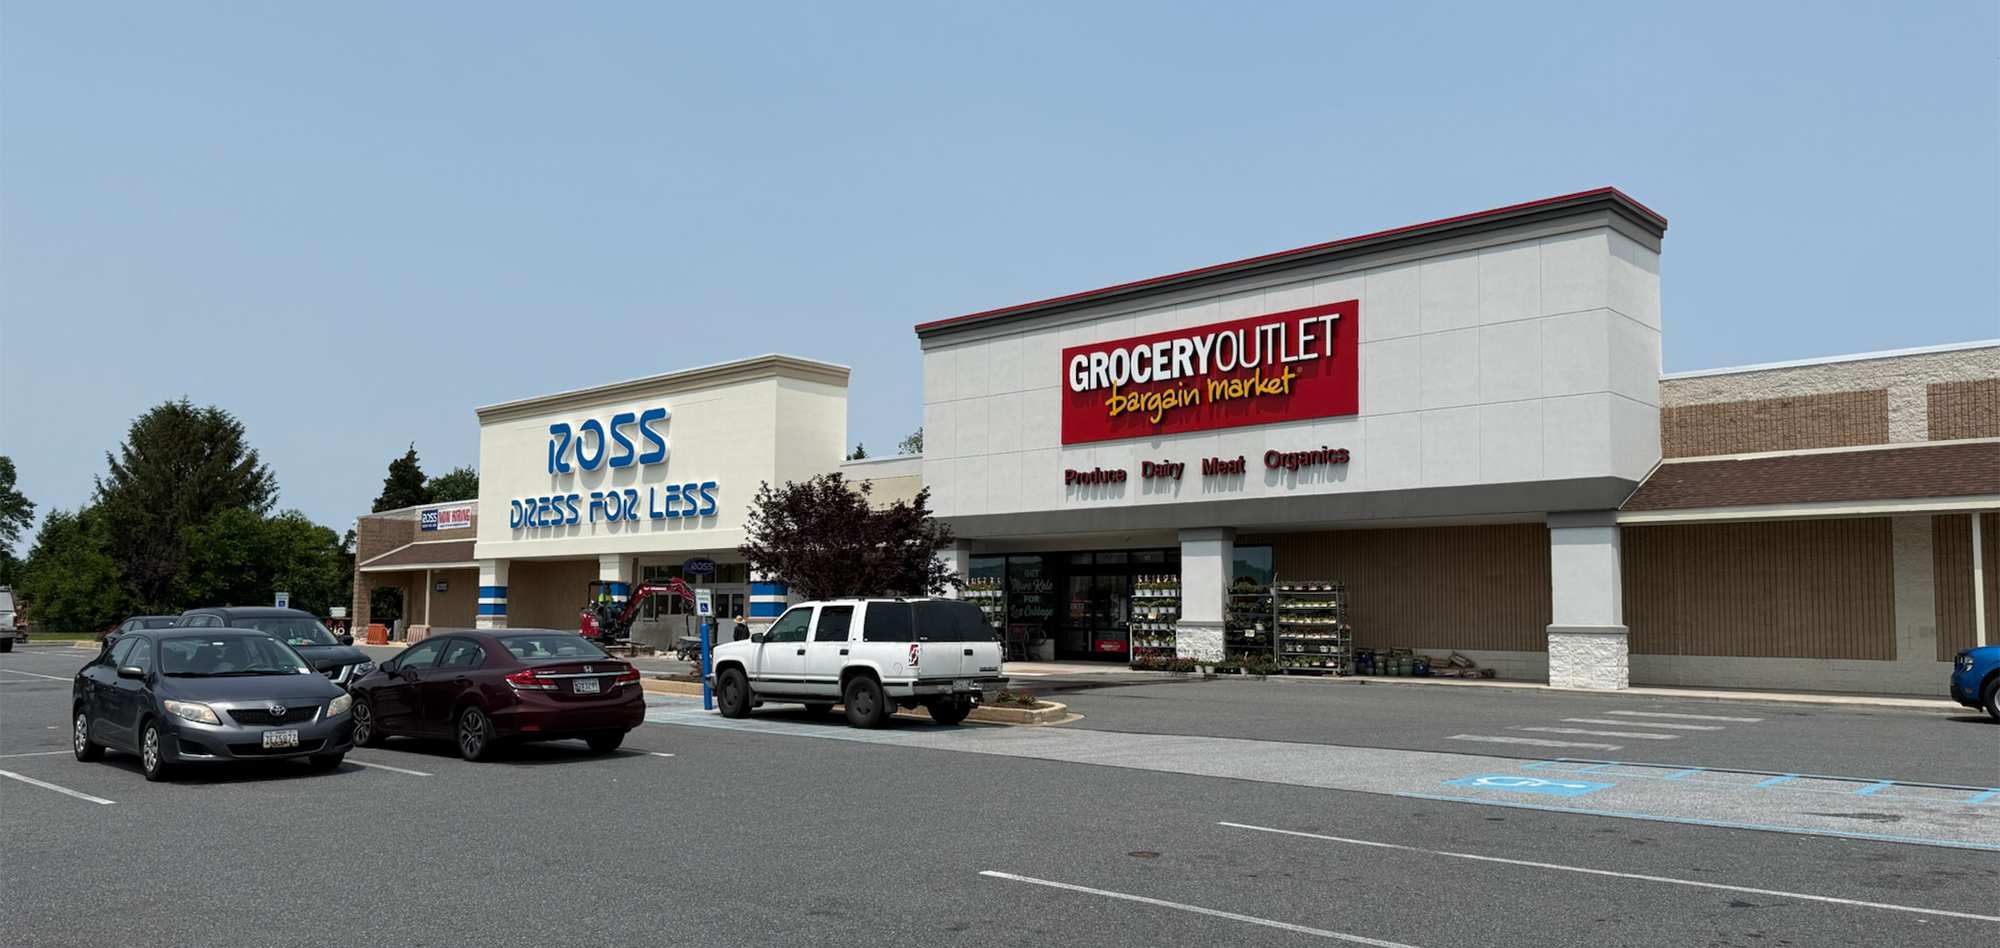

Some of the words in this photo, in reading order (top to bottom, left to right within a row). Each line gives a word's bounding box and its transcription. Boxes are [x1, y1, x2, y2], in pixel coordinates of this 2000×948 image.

[1105, 379, 1200, 423] bargain
[1207, 367, 1297, 402] market
[548, 408, 668, 474] ROSS
[1064, 467, 1127, 486] Produce
[1141, 459, 1184, 481] Dairy
[1202, 454, 1246, 476] Meat
[1263, 445, 1349, 471] Organics
[511, 494, 580, 529] DRESS
[589, 489, 640, 523] FOR
[649, 481, 718, 519] LESS
[690, 561, 714, 570] ROSS
